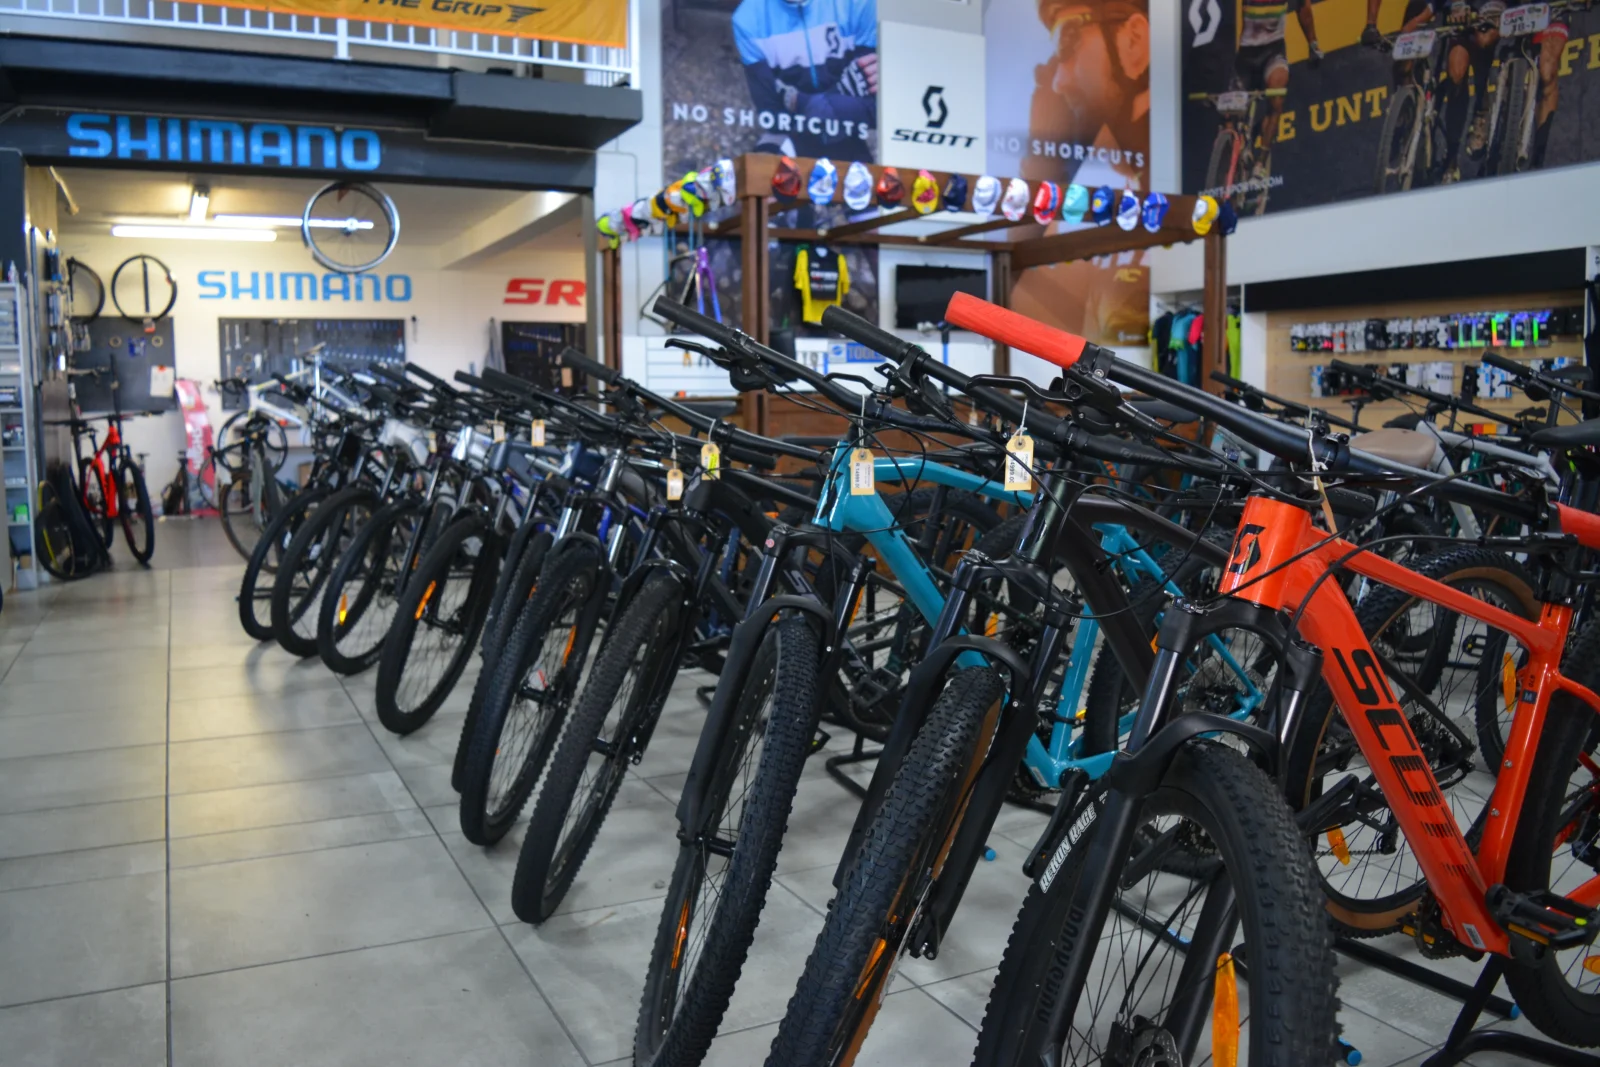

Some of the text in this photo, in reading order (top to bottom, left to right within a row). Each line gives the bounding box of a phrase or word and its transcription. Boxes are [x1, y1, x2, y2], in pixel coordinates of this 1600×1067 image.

[361, 0, 503, 17] HE GRIP
[673, 103, 869, 140] NO SHORTCUTS
[67, 113, 381, 171] SHIMANO
[891, 129, 978, 148] SCOTT
[994, 137, 1145, 168] NO SHORTCUTS
[197, 271, 412, 302] SHIMANO
